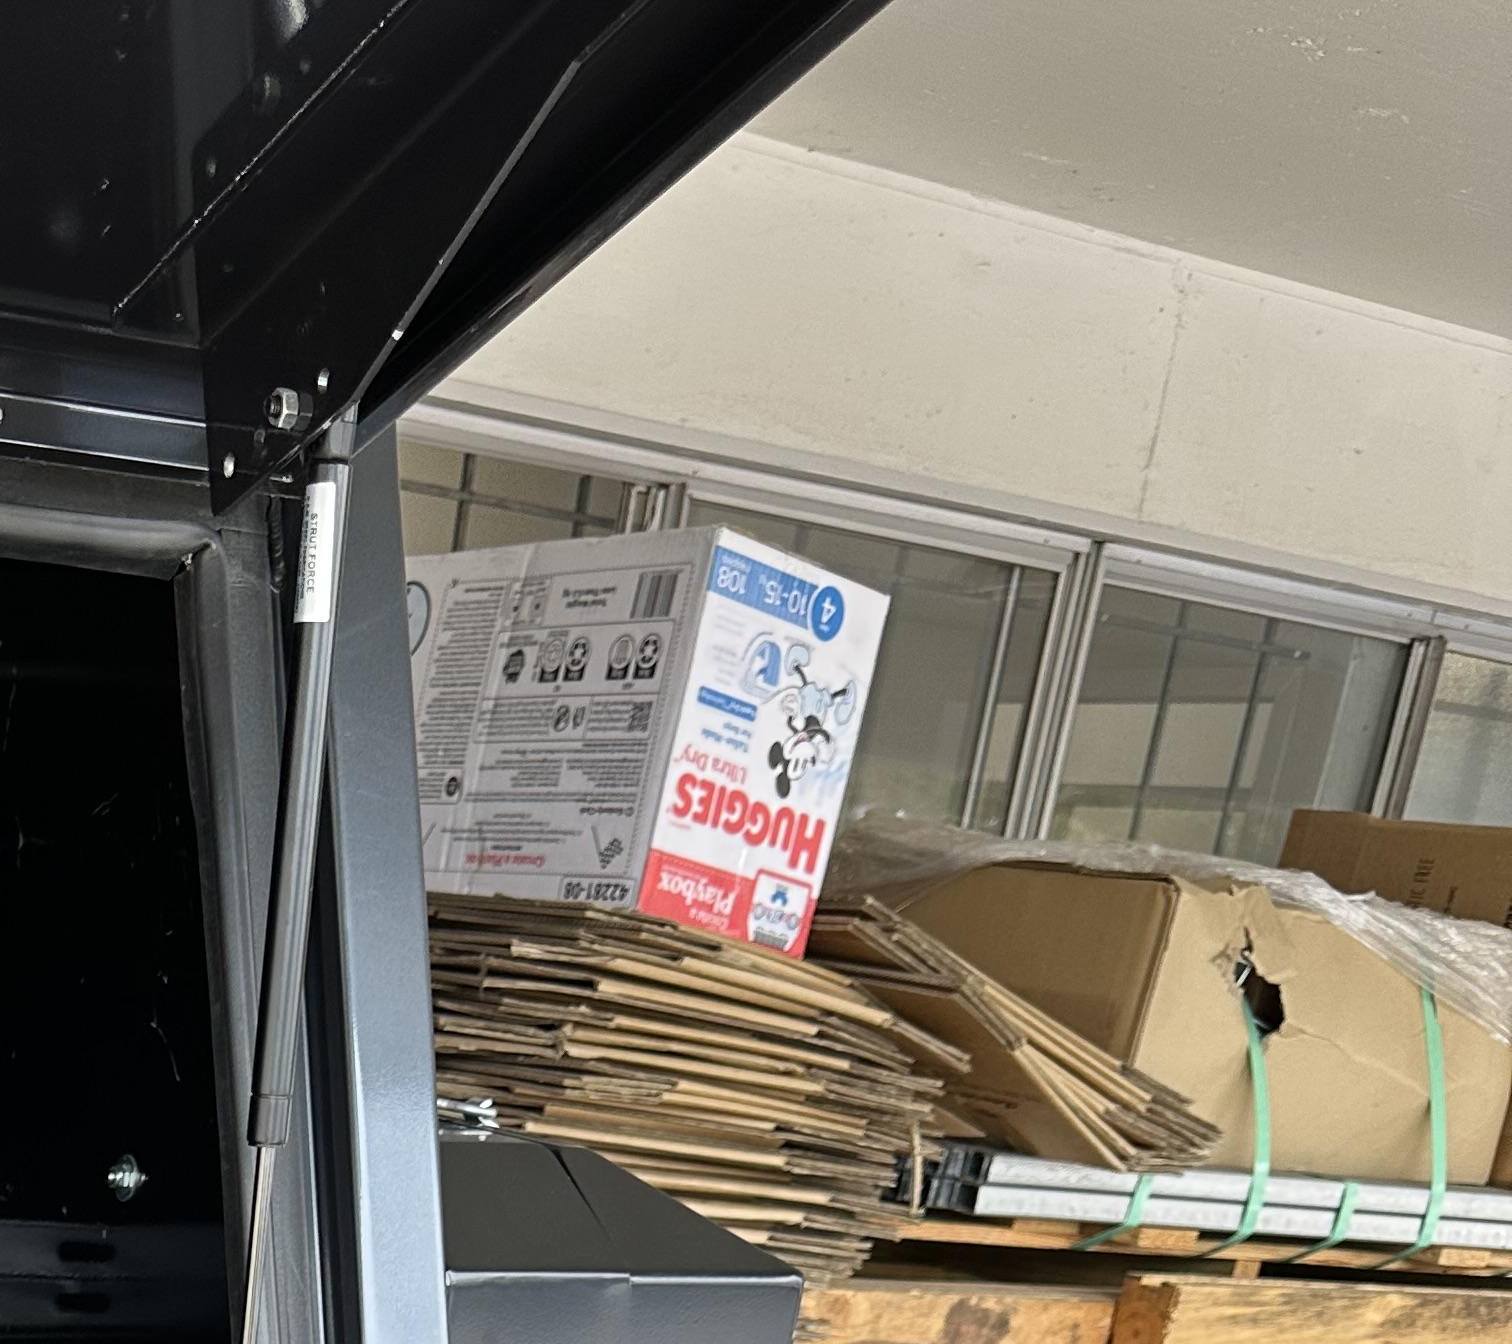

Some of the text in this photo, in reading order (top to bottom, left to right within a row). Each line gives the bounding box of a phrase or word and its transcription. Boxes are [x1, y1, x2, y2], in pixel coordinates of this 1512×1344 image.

[308, 512, 319, 552] STRUT
[306, 554, 317, 593] FORCE
[718, 567, 748, 595] 108
[820, 595, 838, 623] 4
[681, 745, 748, 785] Ultra Dry
[671, 773, 826, 874] HUGGIES
[658, 871, 735, 910] Playbox
